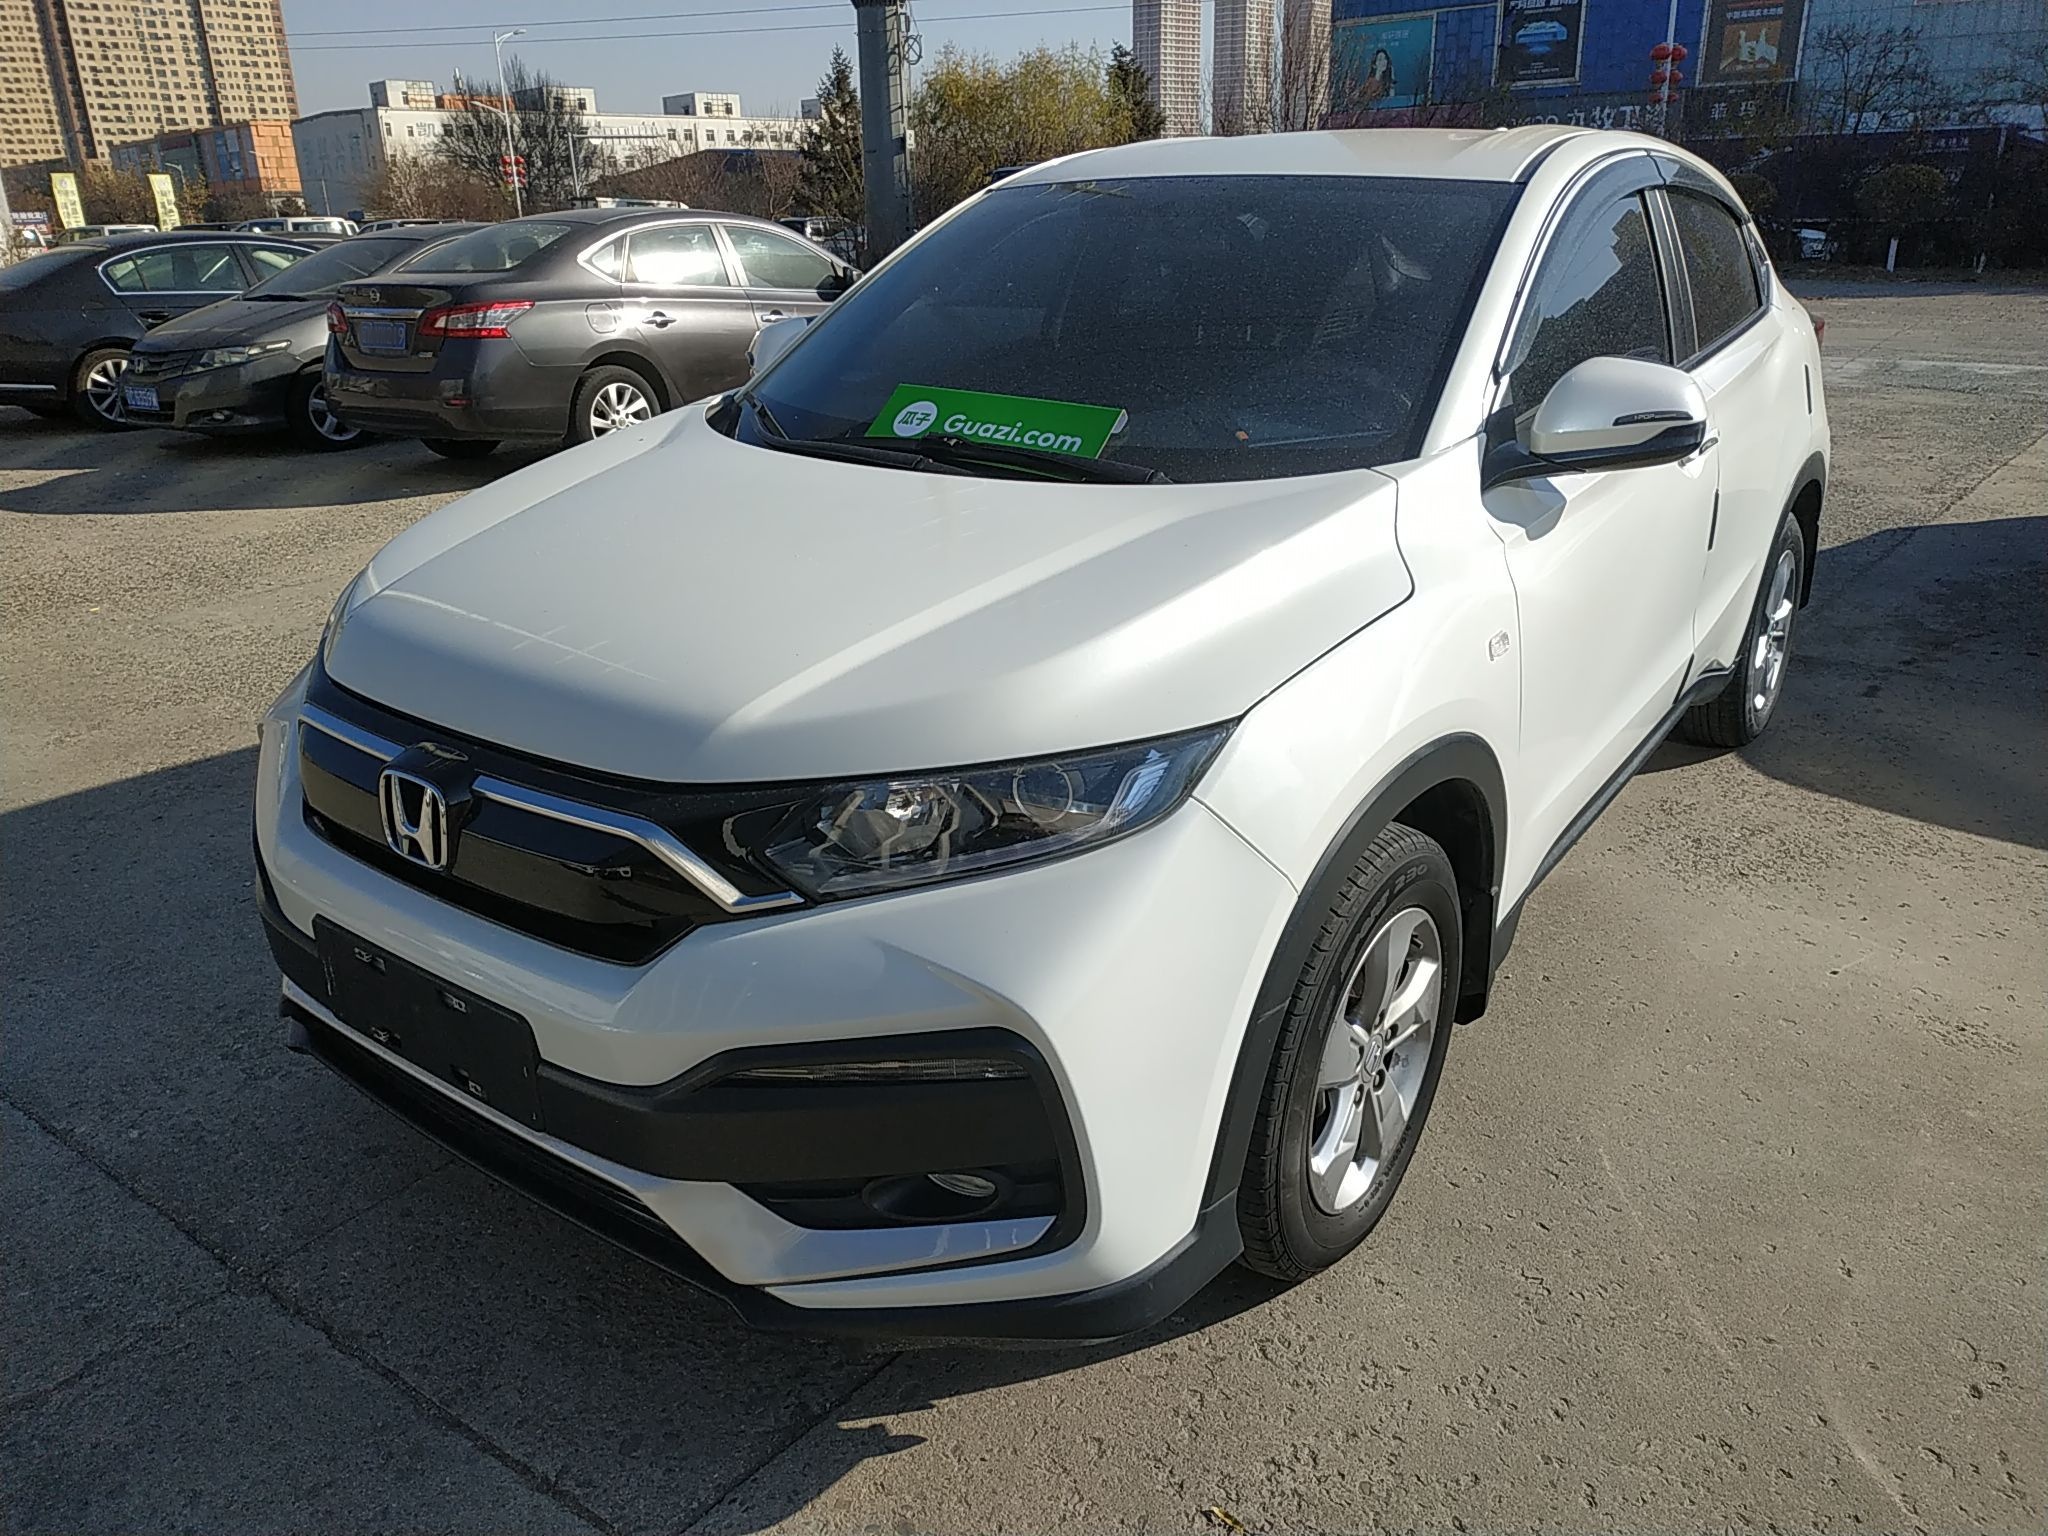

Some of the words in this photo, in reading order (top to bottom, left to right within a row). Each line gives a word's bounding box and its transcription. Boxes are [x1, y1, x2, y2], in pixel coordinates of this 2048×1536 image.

[416, 121, 439, 138] 凯
[897, 410, 932, 426] 瓜子
[943, 414, 1083, 453] Guazi.com
